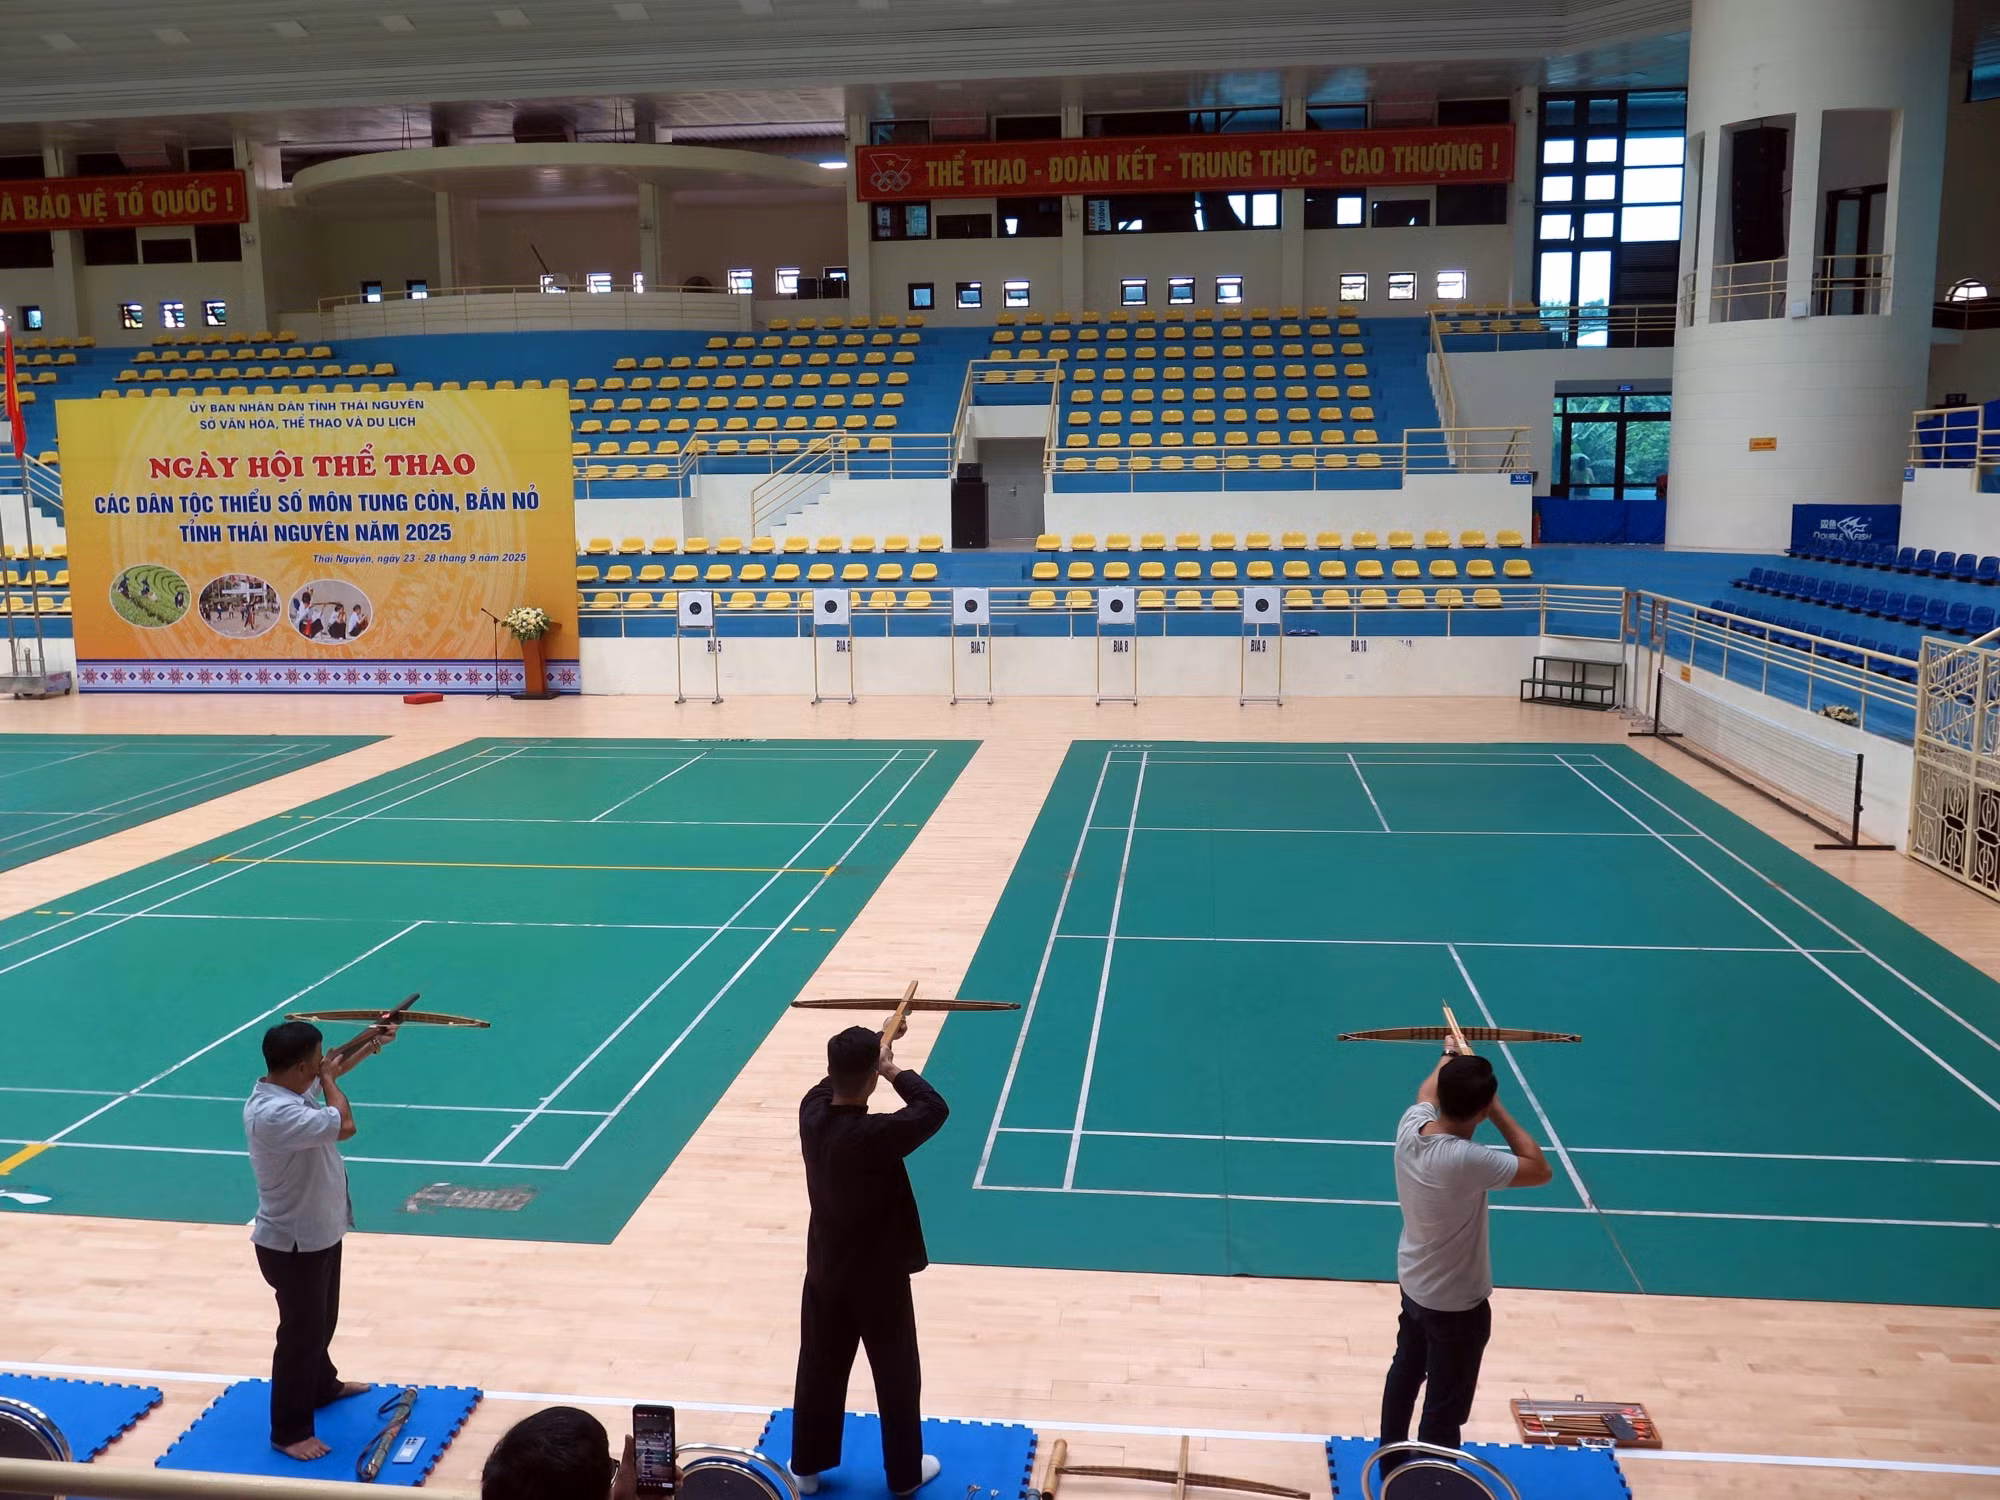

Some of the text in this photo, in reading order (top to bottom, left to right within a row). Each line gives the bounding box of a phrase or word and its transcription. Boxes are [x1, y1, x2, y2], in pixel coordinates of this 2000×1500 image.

[925, 149, 965, 187] THỂ
[971, 159, 1027, 185] THAO
[1049, 150, 1109, 183] ĐOÀN
[1116, 145, 1158, 181] KẾT
[1178, 151, 1253, 179] TRUNG
[1259, 146, 1317, 182] THỰC
[1340, 147, 1385, 175] CAO
[1392, 141, 1483, 178] THƯỢNG
[0, 191, 17, 221] À
[23, 185, 71, 220] BẢO
[77, 187, 108, 223] VỆ
[114, 180, 144, 216] TỔ
[151, 179, 217, 218] QUỐC
[190, 398, 424, 413] ỦY BAN NHÂN DÂN TỈNH THÁI NGUYÊN
[200, 413, 416, 430] SỞ VĂN HÓA, THỂ THAO VÀ DU LỊCH
[149, 443, 476, 483] NGÀY HỘI THỂ THAO
[95, 484, 539, 517] CÁC DÂN TỘC THIỂU SỐ MÔN TUNG CÒN, BẮN NỎ
[179, 518, 452, 542] TỈNH THÁI NGUYÊN NĂM 2025
[1813, 531, 1845, 540] DOUBLE
[403, 553, 416, 562] 23
[424, 553, 436, 562] 28
[469, 553, 476, 562] 9
[502, 553, 527, 562] 2025
[718, 640, 722, 652] 5
[836, 640, 846, 652] BIA
[970, 641, 986, 653] BIA 7
[1113, 640, 1129, 652] BIA 8
[1250, 640, 1267, 652] BIA 9
[1351, 640, 1367, 652] BIA 10
